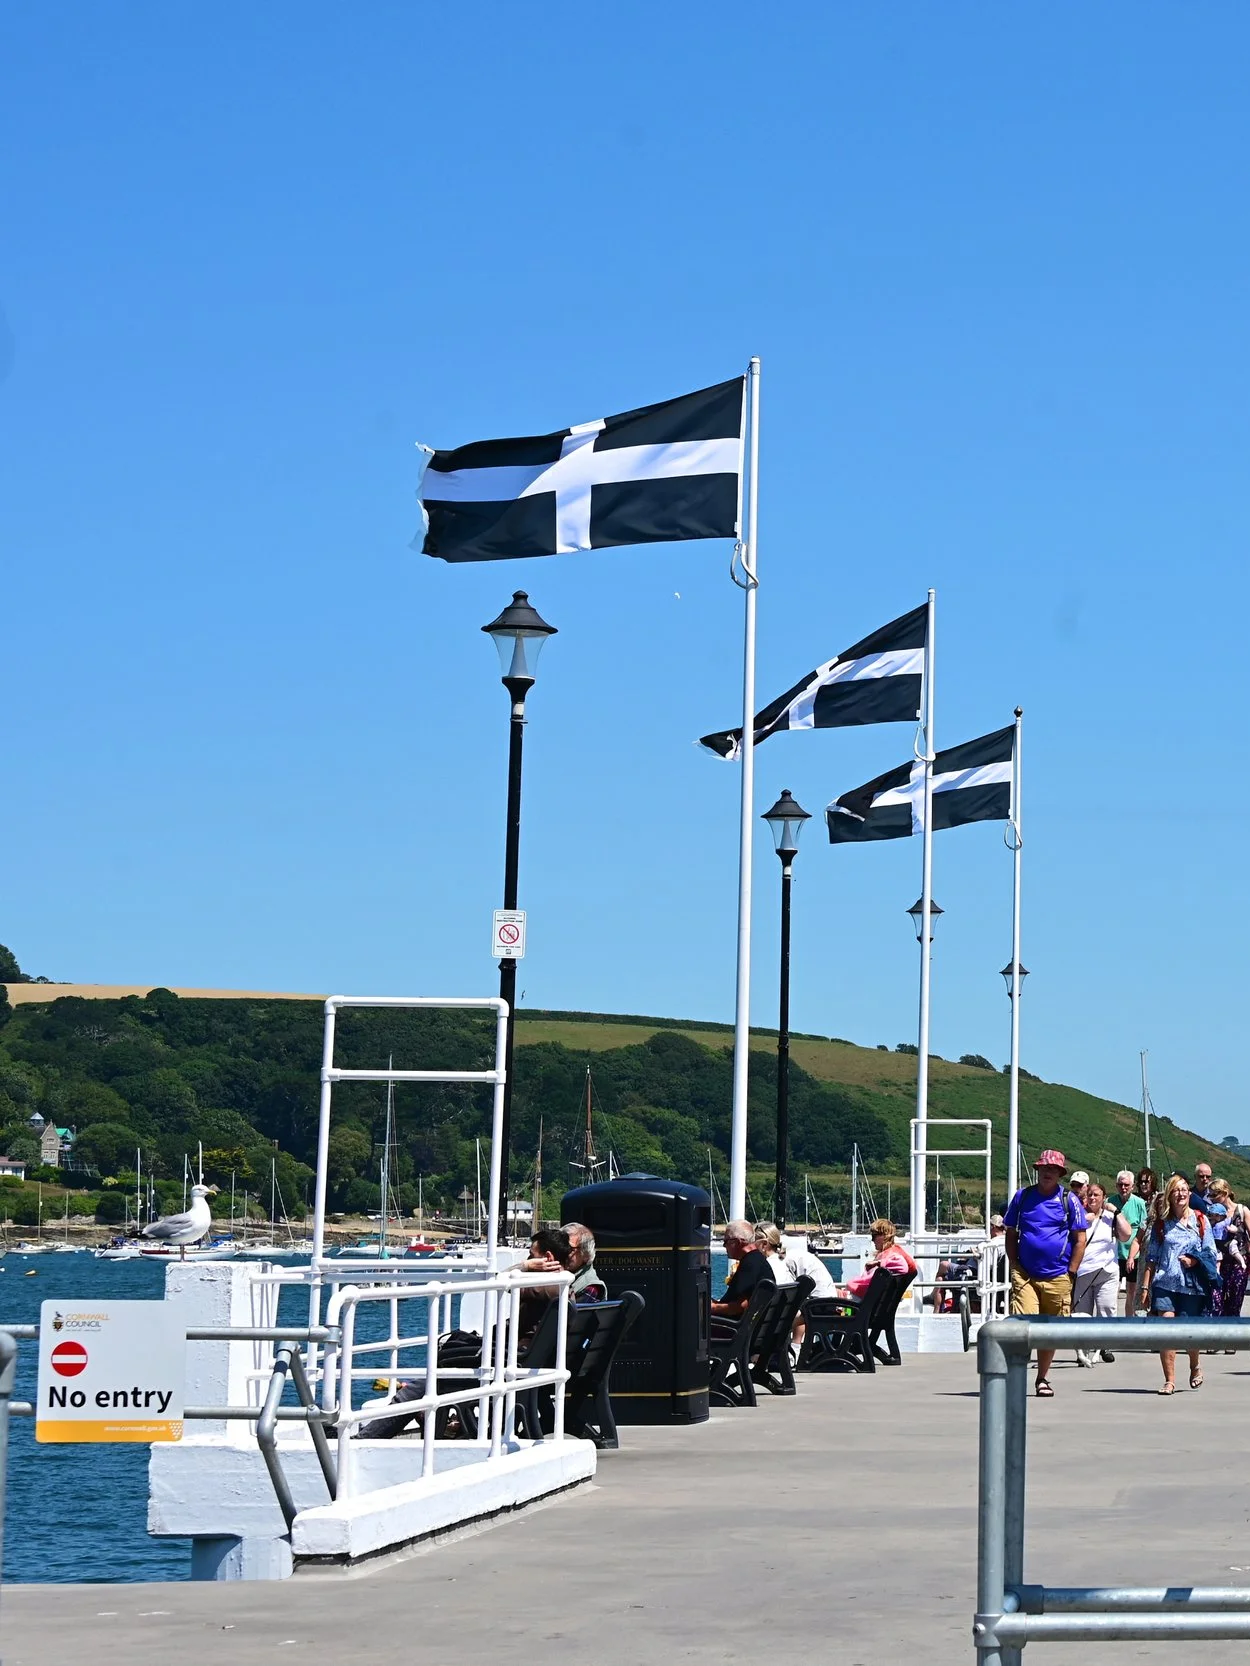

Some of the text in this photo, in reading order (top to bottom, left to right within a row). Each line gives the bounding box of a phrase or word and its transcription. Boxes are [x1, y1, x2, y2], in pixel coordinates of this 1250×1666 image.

[65, 1313, 110, 1321] CORNWALL
[48, 1386, 173, 1414] No entry
